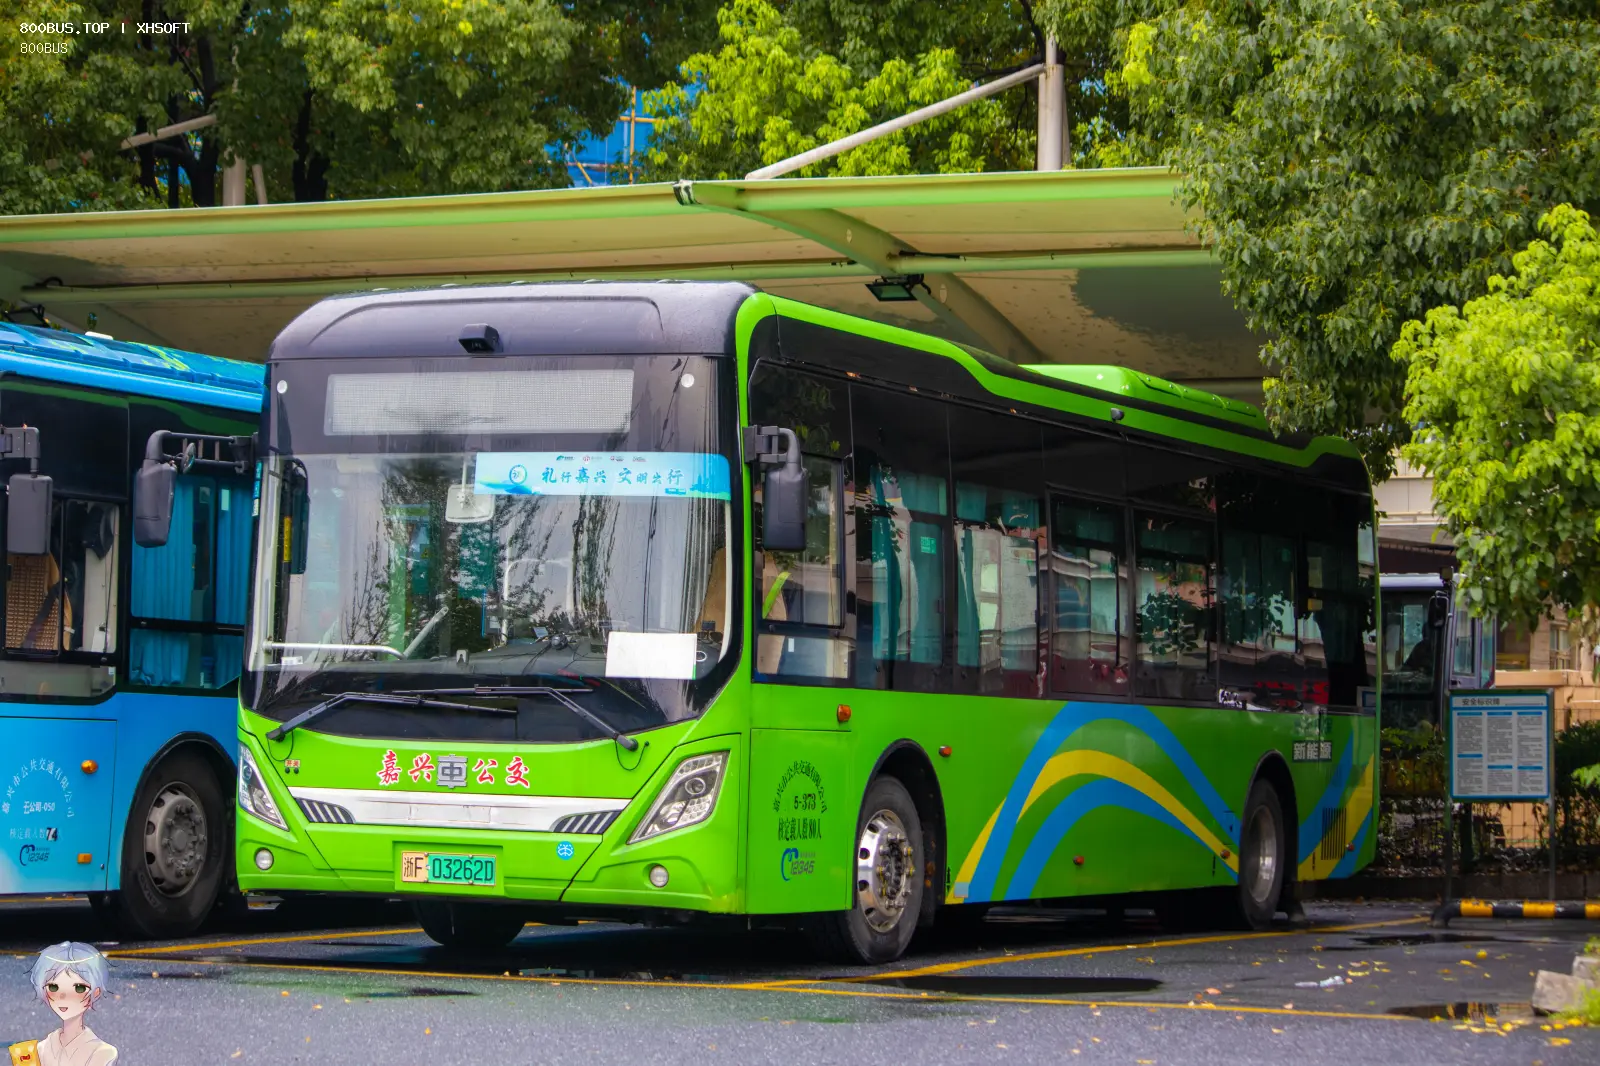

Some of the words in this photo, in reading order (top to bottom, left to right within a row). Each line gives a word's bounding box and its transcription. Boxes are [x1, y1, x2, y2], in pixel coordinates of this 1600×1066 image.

[541, 466, 608, 485] 礼行嘉兴
[617, 467, 685, 486] 文明出行
[1293, 742, 1332, 760] 新能源
[377, 749, 436, 787] 嘉兴
[472, 756, 531, 788] 公交
[793, 793, 817, 811] 5-373
[432, 857, 494, 882] 03262D
